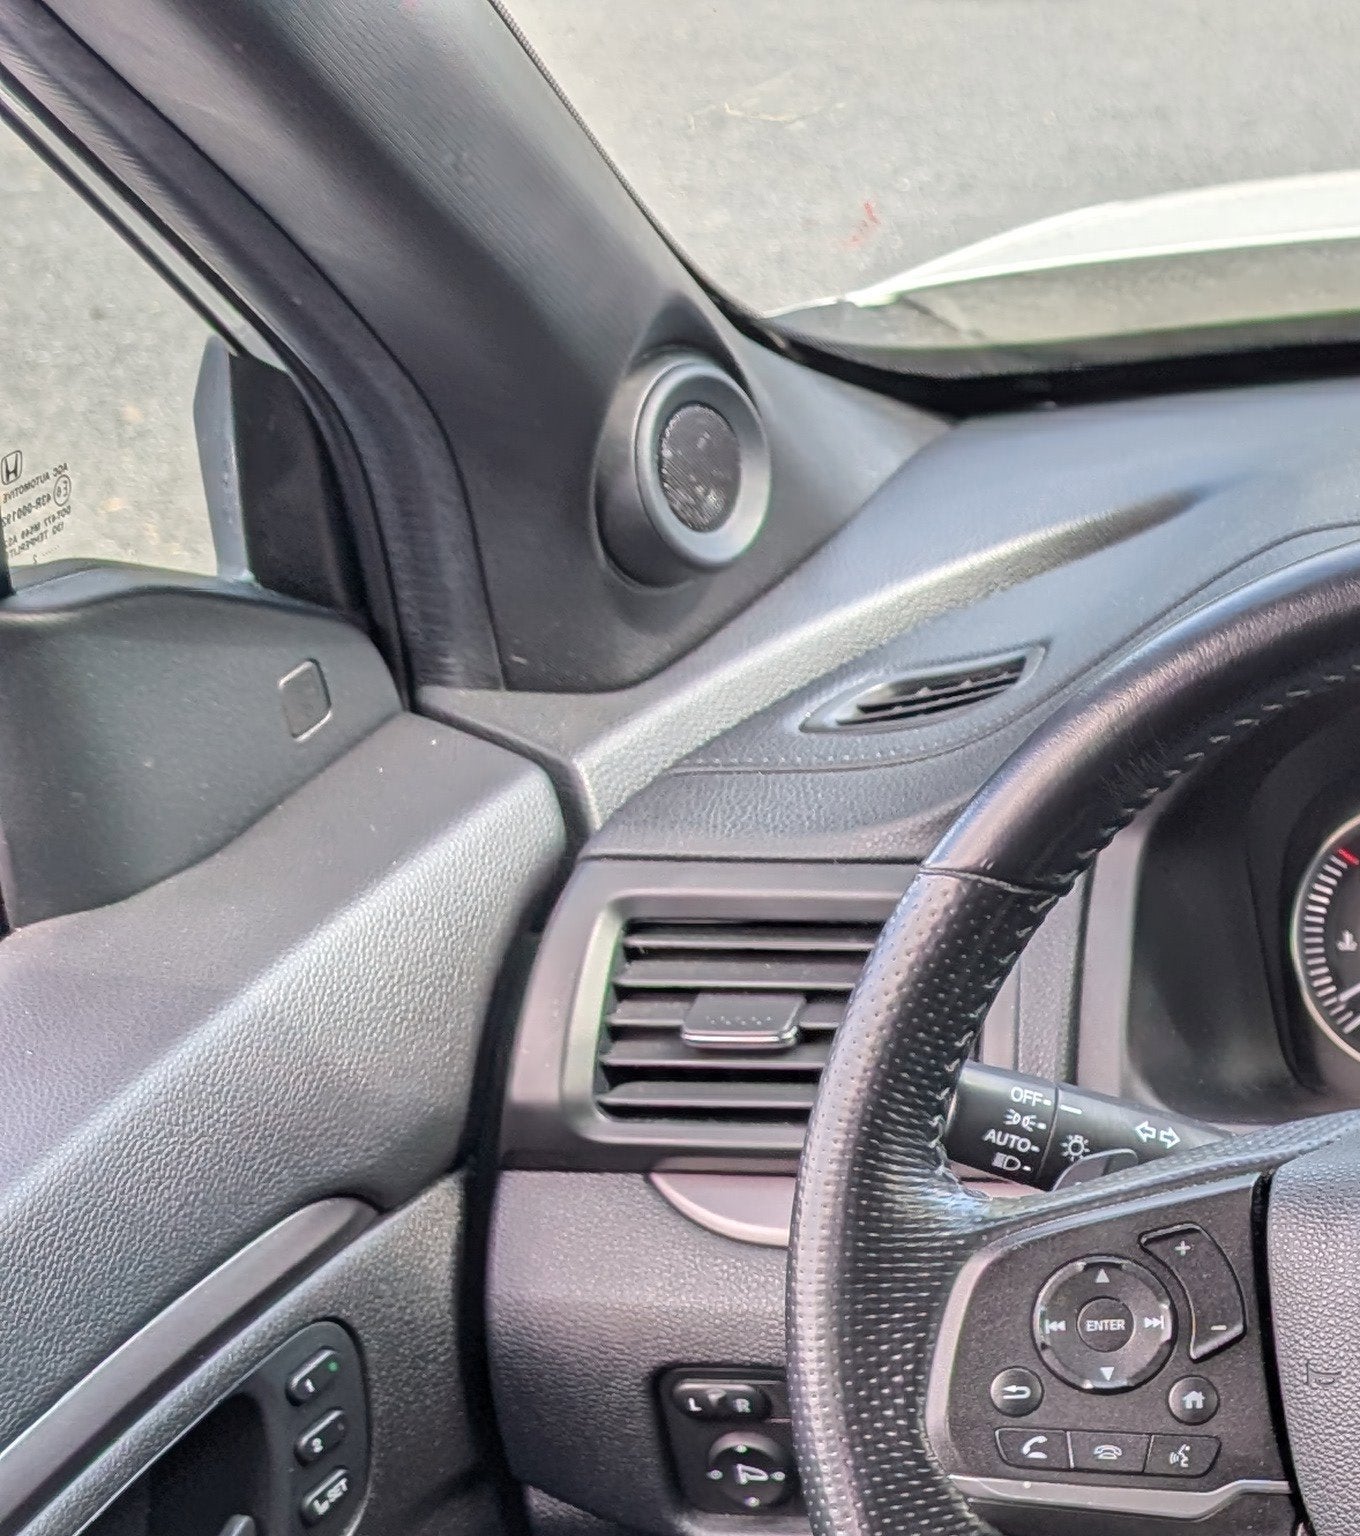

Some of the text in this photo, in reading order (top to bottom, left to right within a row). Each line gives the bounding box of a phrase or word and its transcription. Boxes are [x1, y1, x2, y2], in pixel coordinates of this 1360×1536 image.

[1011, 1086, 1043, 1107] OFF
[984, 1128, 1031, 1153] AUTO
[1085, 1318, 1126, 1333] ENTER
[688, 1397, 702, 1412] L
[734, 1398, 751, 1413] R
